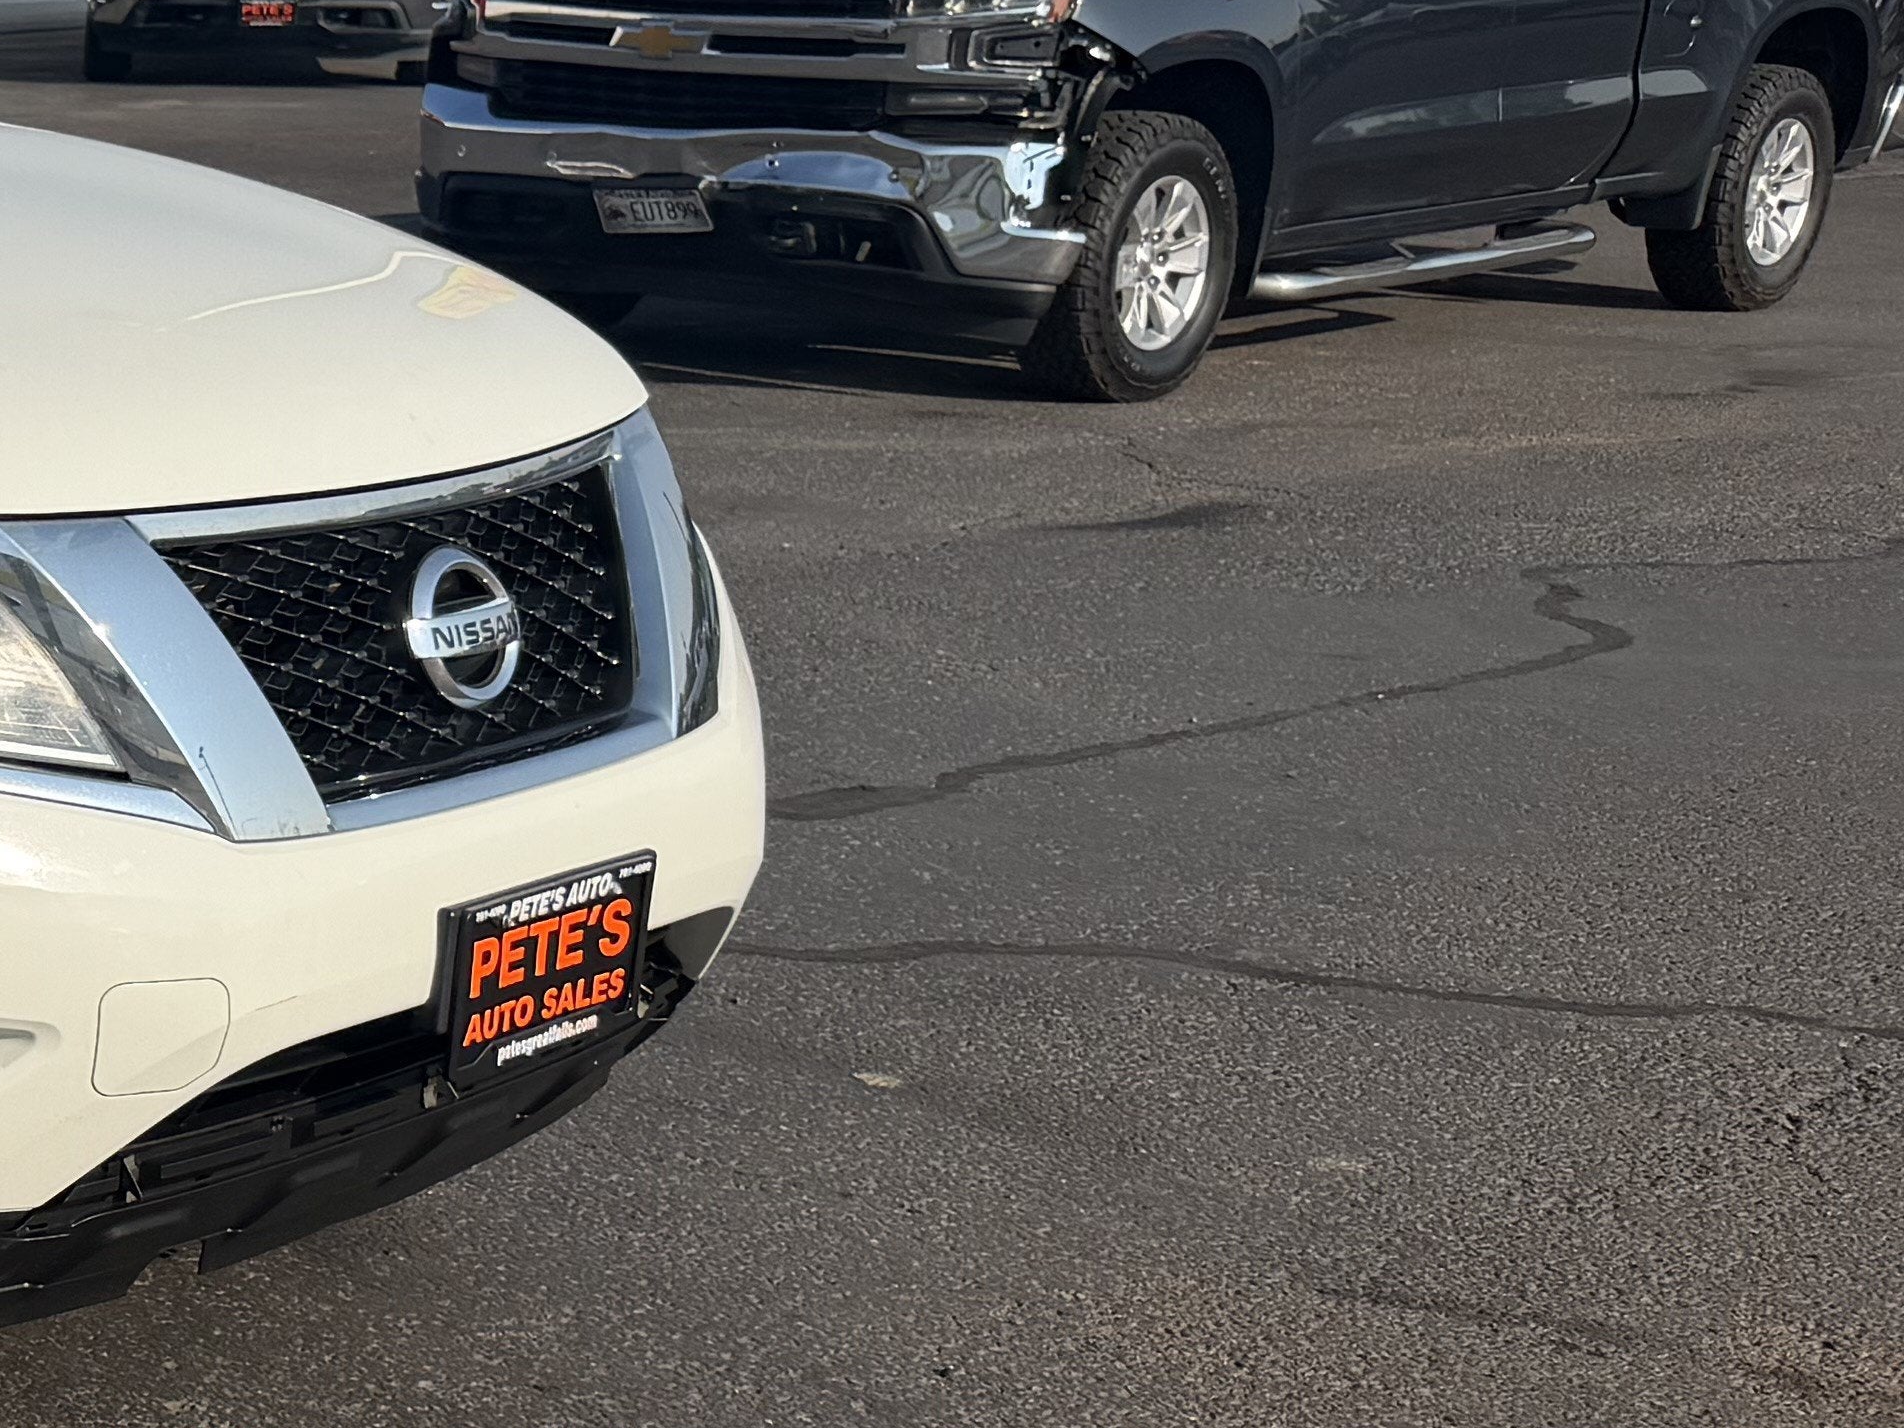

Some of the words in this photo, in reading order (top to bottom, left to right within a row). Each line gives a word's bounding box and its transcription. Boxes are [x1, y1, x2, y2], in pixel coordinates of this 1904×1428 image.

[430, 612, 520, 651] NISSAN
[510, 886, 567, 922] PETE'S
[566, 872, 613, 907] AUTO
[468, 898, 633, 999] PETE'S
[462, 995, 535, 1047] AUTO
[541, 967, 626, 1020] SALES
[496, 1015, 598, 1067] petesgreatfalls.com
